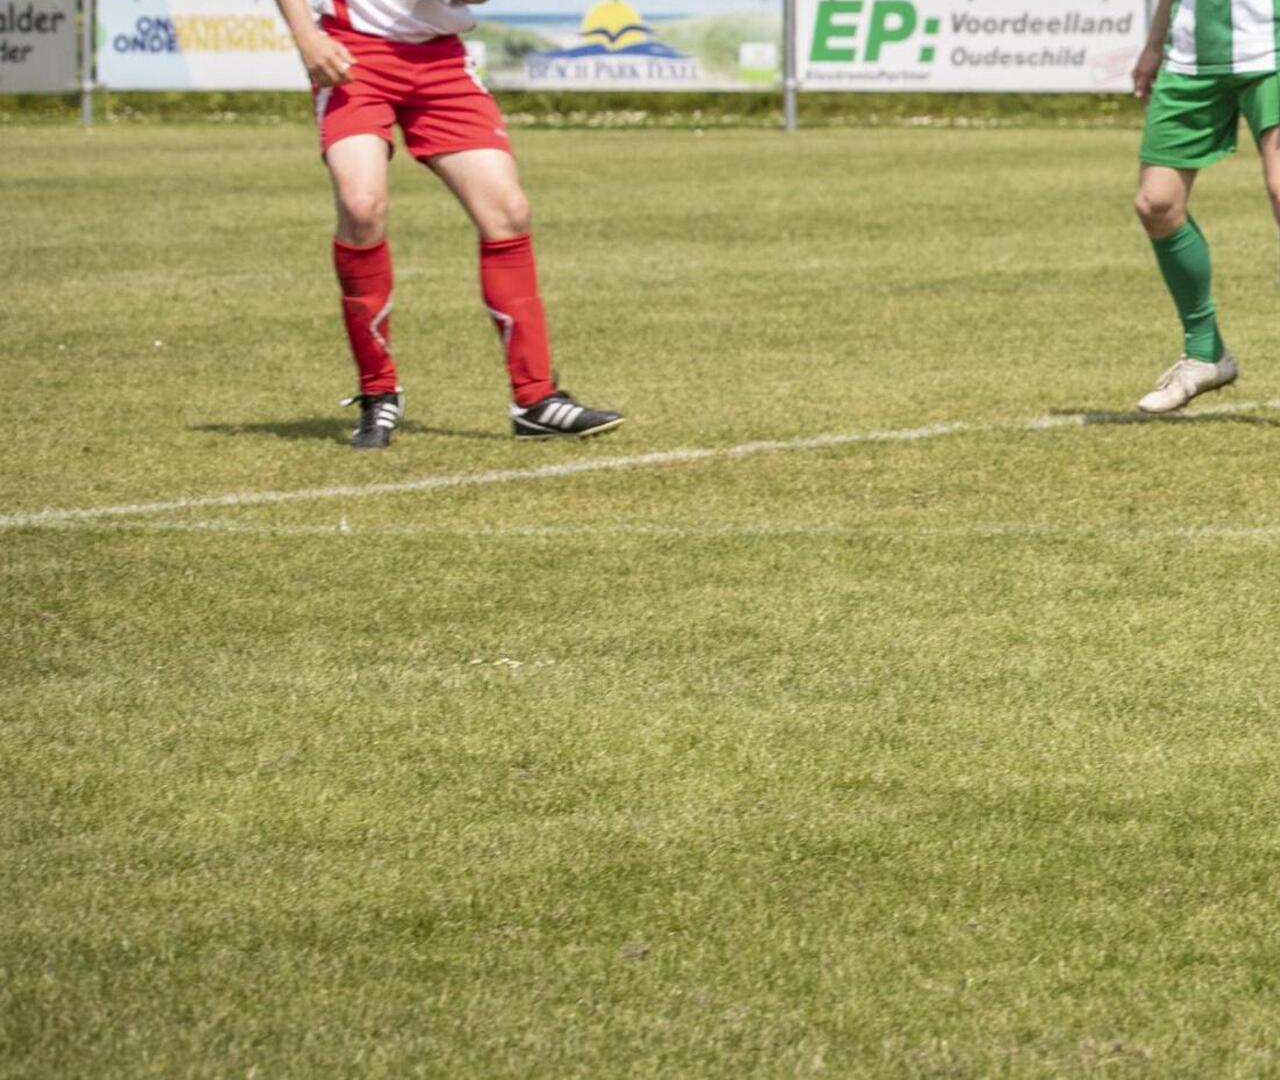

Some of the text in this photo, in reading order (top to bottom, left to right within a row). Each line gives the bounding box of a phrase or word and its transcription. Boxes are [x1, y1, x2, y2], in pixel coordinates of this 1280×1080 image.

[809, 0, 940, 63] EP:
[951, 12, 1133, 35] Voordeelland
[951, 46, 1086, 67] Oudeschild
